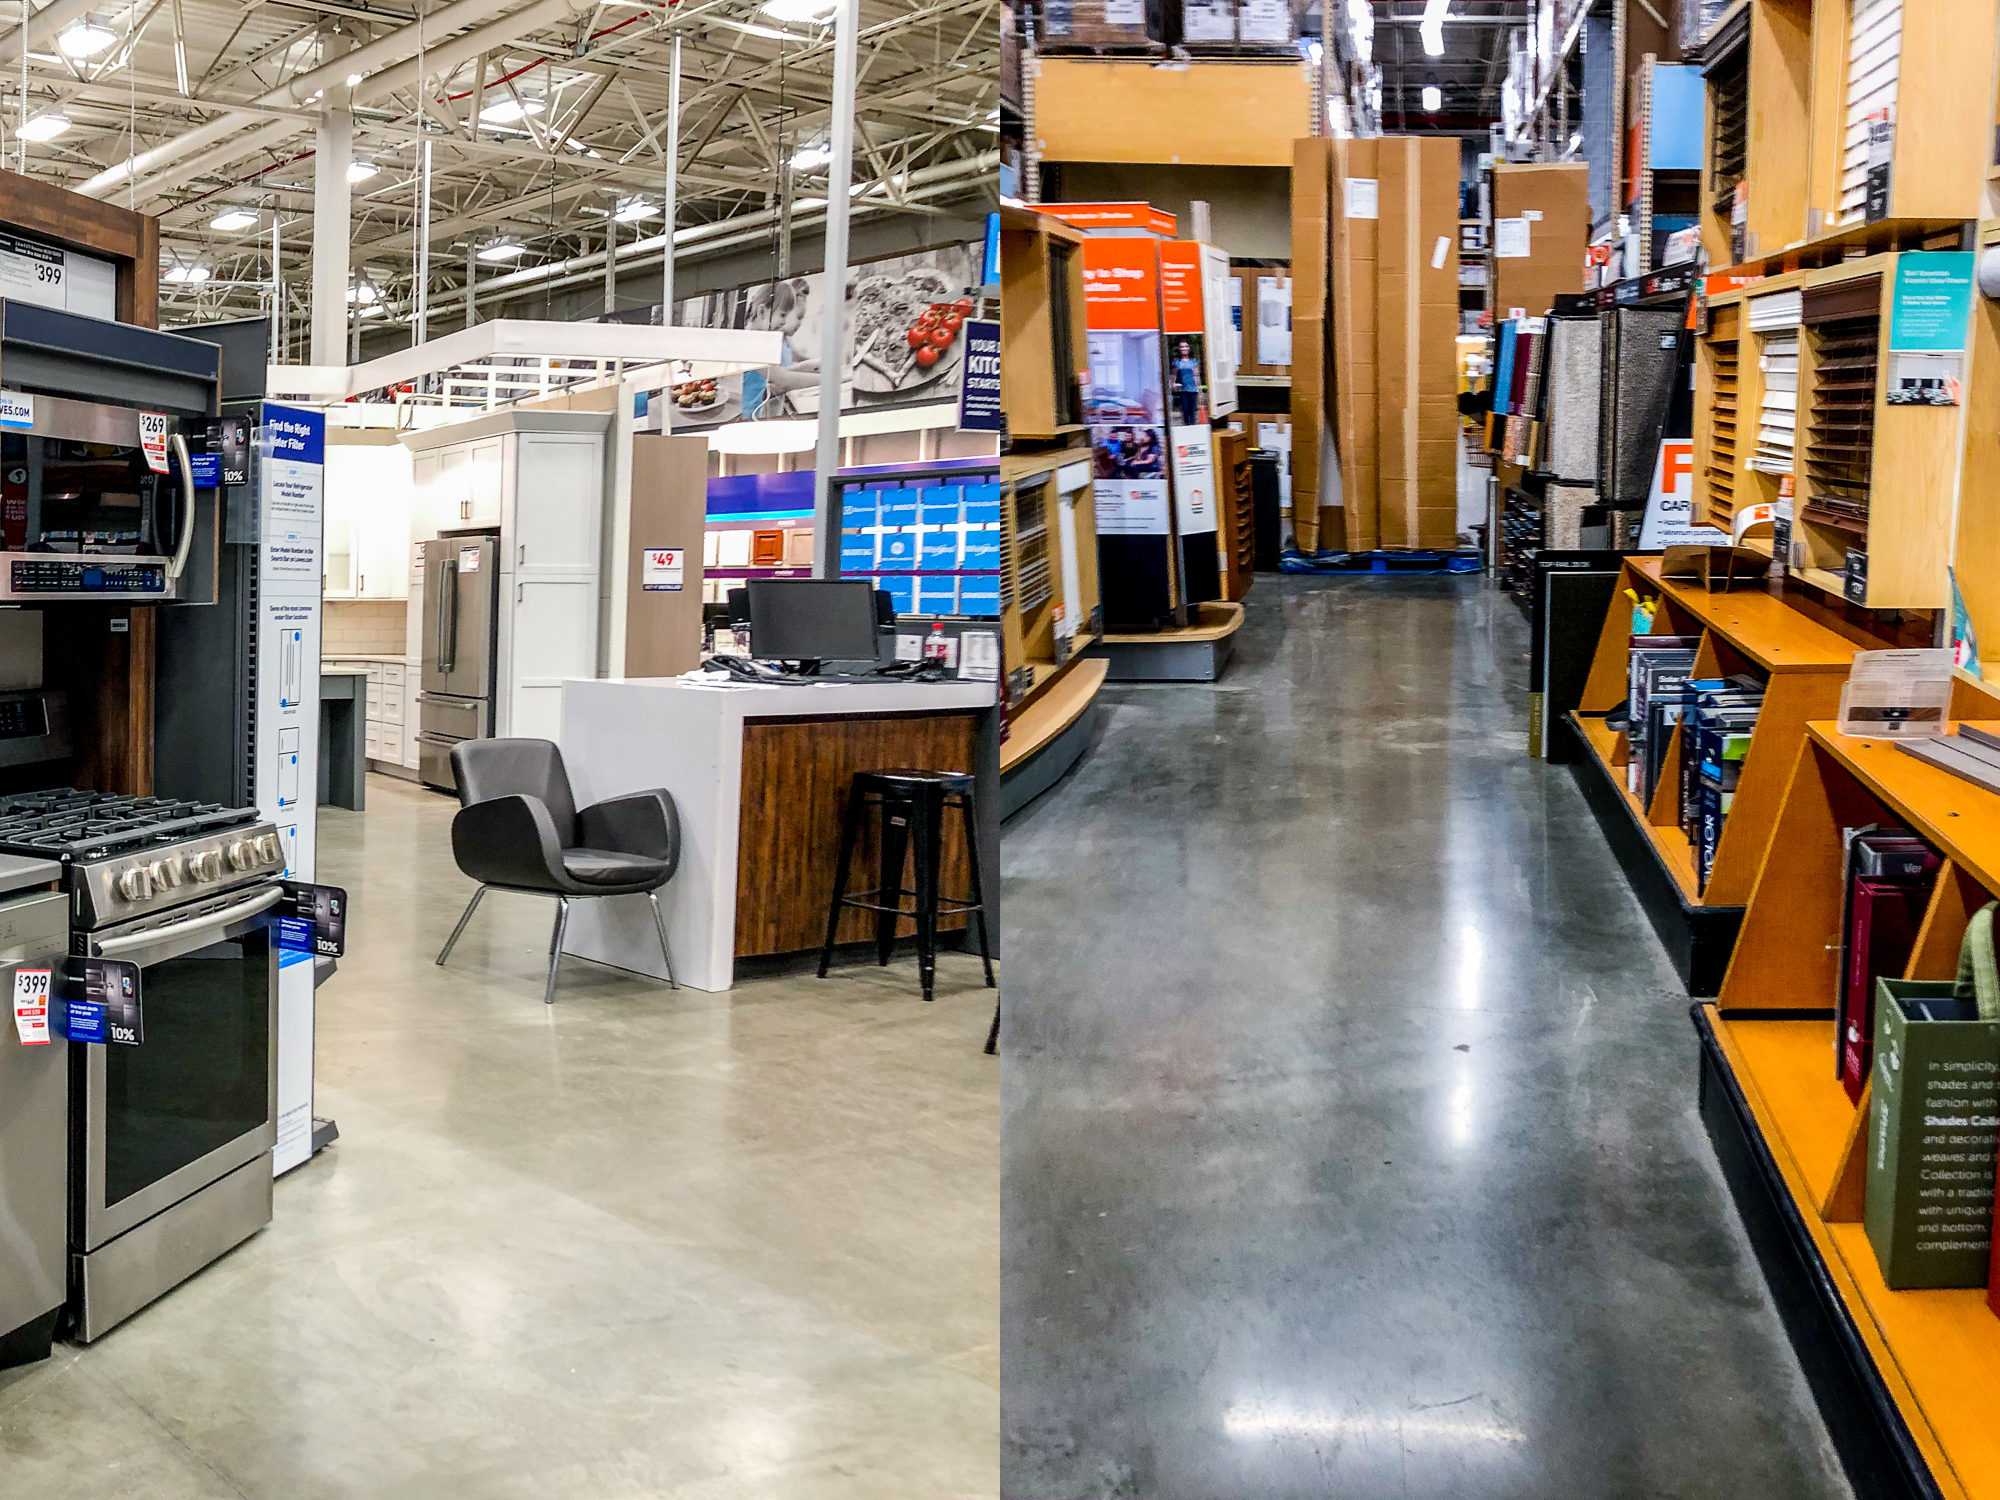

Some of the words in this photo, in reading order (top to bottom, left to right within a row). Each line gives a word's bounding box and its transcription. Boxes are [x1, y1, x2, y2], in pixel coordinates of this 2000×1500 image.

[34, 263, 62, 285] $399
[969, 339, 997, 353] YOUR
[141, 415, 164, 433] $269
[269, 418, 284, 432] Find
[284, 421, 295, 433] the
[294, 422, 311, 437] Right
[288, 437, 305, 451] Filter
[223, 470, 244, 482] 10%
[652, 552, 674, 566] $49
[316, 939, 338, 952] 10%
[18, 974, 48, 993] $399
[110, 1026, 135, 1041] 10%
[1927, 1079, 1969, 1090] shades
[1971, 1079, 1994, 1090] and
[1925, 1097, 1969, 1108] fashion
[1972, 1097, 1998, 1108] with
[1924, 1115, 1969, 1126] Shades
[1924, 1134, 1946, 1144] and
[1922, 1153, 1966, 1162] weaves
[1968, 1152, 1990, 1162] and
[1920, 1169, 1981, 1180] Collection
[1984, 1170, 1993, 1180] is
[1920, 1187, 1945, 1197] with
[1947, 1188, 1955, 1197] a
[1918, 1205, 1943, 1215] with
[1946, 1206, 1986, 1216] unique
[1917, 1223, 1939, 1233] and
